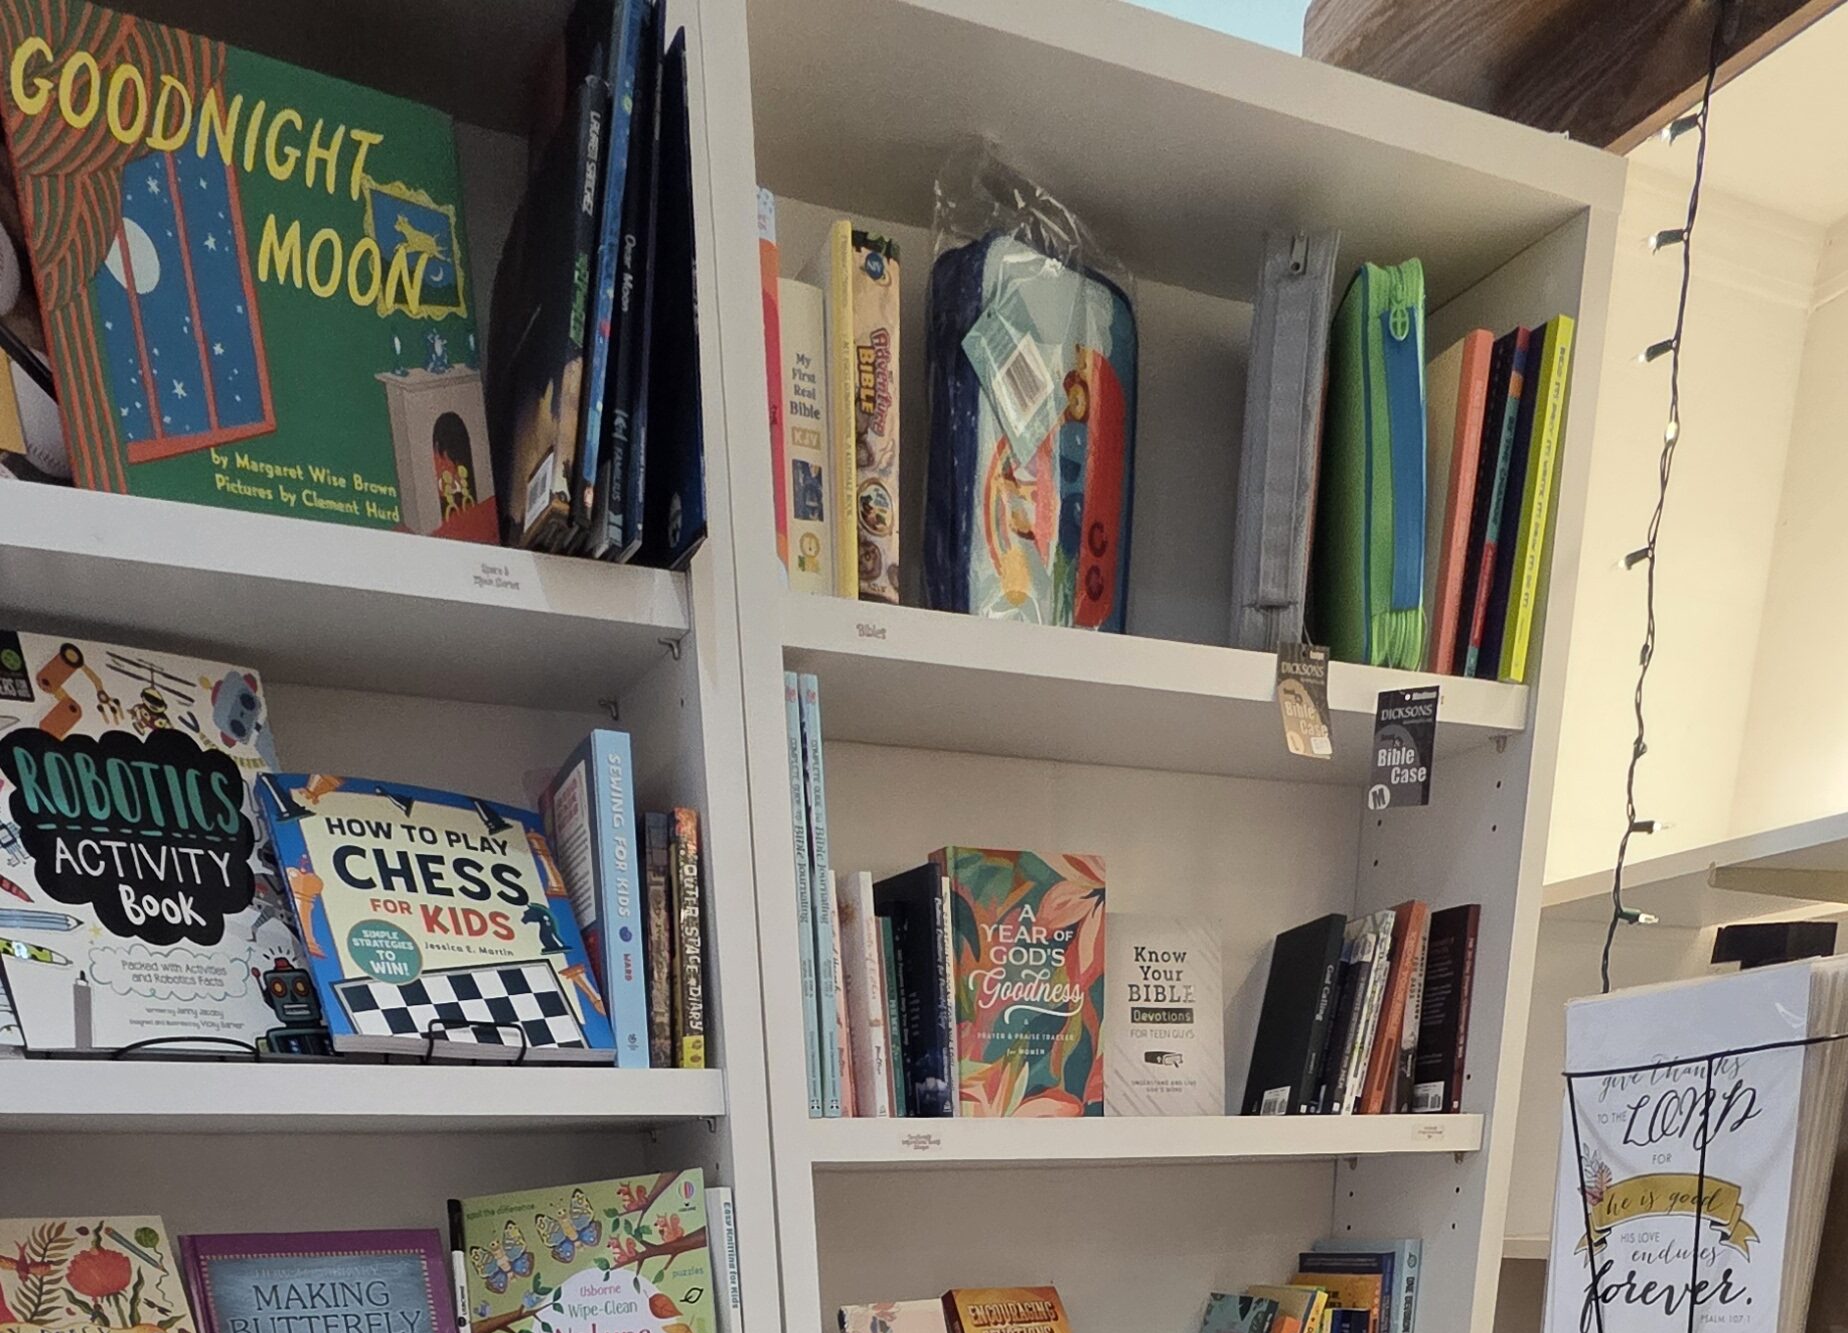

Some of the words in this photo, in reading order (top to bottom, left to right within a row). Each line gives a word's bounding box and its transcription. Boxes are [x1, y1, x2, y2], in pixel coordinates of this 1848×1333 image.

[10, 37, 382, 200] GOODNIGHT
[258, 213, 430, 316] MOON
[797, 353, 811, 368] My
[793, 368, 816, 383] First
[857, 345, 876, 416] BIBLE
[871, 328, 892, 437] Adventure
[794, 384, 816, 400] Real
[790, 400, 820, 420] Bible
[210, 448, 228, 469] by
[235, 452, 304, 479] Margaret
[309, 465, 346, 488] Wise
[353, 473, 396, 497] Brown
[215, 474, 273, 500] Pictures
[279, 485, 296, 506] by
[302, 490, 359, 515] Clement
[366, 502, 399, 522] Hurd
[856, 624, 887, 640] Bibles
[1281, 661, 1324, 677] DICKSONS
[1285, 701, 1315, 720] Bible
[1381, 704, 1433, 722] DICKSONS
[1300, 720, 1328, 736] Case
[1377, 747, 1415, 767] Bible
[1391, 766, 1427, 784] Case
[13, 746, 240, 834] ROBOTICS
[608, 753, 625, 829] SEWING
[325, 817, 393, 840] HOW
[401, 824, 438, 845] TO
[445, 830, 508, 856] PLAY
[55, 836, 230, 888] ACTIVITY
[614, 834, 628, 875] FOR
[333, 845, 530, 906] CHESS
[617, 877, 631, 919] KIDS
[683, 862, 699, 921] OUTER
[370, 898, 413, 915] FOR
[419, 903, 516, 941] KIDS
[1018, 904, 1036, 923] A
[352, 937, 414, 951] STRATEGIES
[362, 929, 399, 941] SIMPLE
[980, 924, 1048, 944] YEAR
[1054, 930, 1073, 942] OF
[376, 950, 396, 962] TO
[424, 942, 464, 953] Jessica
[479, 947, 514, 957] Martin
[684, 924, 701, 979] SPACE
[990, 946, 1066, 967] GOD'S
[1133, 946, 1187, 963] Know
[121, 960, 158, 971] Packed
[161, 962, 183, 973] with
[185, 964, 228, 976] Activities
[370, 961, 409, 977] WIN!
[623, 952, 633, 982] WARD
[1140, 966, 1183, 981] Your
[132, 973, 152, 983] and
[155, 974, 196, 985] Robotics
[200, 976, 224, 987] Facts
[968, 968, 1084, 1016] Goodness
[1128, 984, 1196, 1003] BIBLE
[686, 985, 704, 1031] DIARY
[1133, 1009, 1192, 1021] Devotions
[1130, 1029, 1147, 1039] FOR
[1150, 1029, 1171, 1039] TEEN
[1172, 1029, 1195, 1039] GUYS
[1601, 1073, 1641, 1102] give
[1650, 1052, 1749, 1085] thanks
[1597, 1112, 1609, 1124] TO
[1611, 1111, 1627, 1124] THE
[1622, 1080, 1762, 1150] LORD
[1652, 1153, 1672, 1164] FOR
[1606, 1192, 1630, 1216] he
[1640, 1196, 1658, 1210] is
[1666, 1190, 1724, 1216] good
[722, 1201, 733, 1226] Easy
[724, 1227, 737, 1268] Knitting
[1620, 1233, 1636, 1244] HIS
[1638, 1232, 1660, 1243] LOVE
[672, 1266, 704, 1278] puzzles
[729, 1270, 737, 1284] for
[252, 1281, 389, 1311] MAKING
[580, 1283, 621, 1297] Usborne
[730, 1286, 740, 1308] Kids
[568, 1299, 638, 1318] Wipe-Clean
[968, 1301, 1059, 1327] ENCOURAGING
